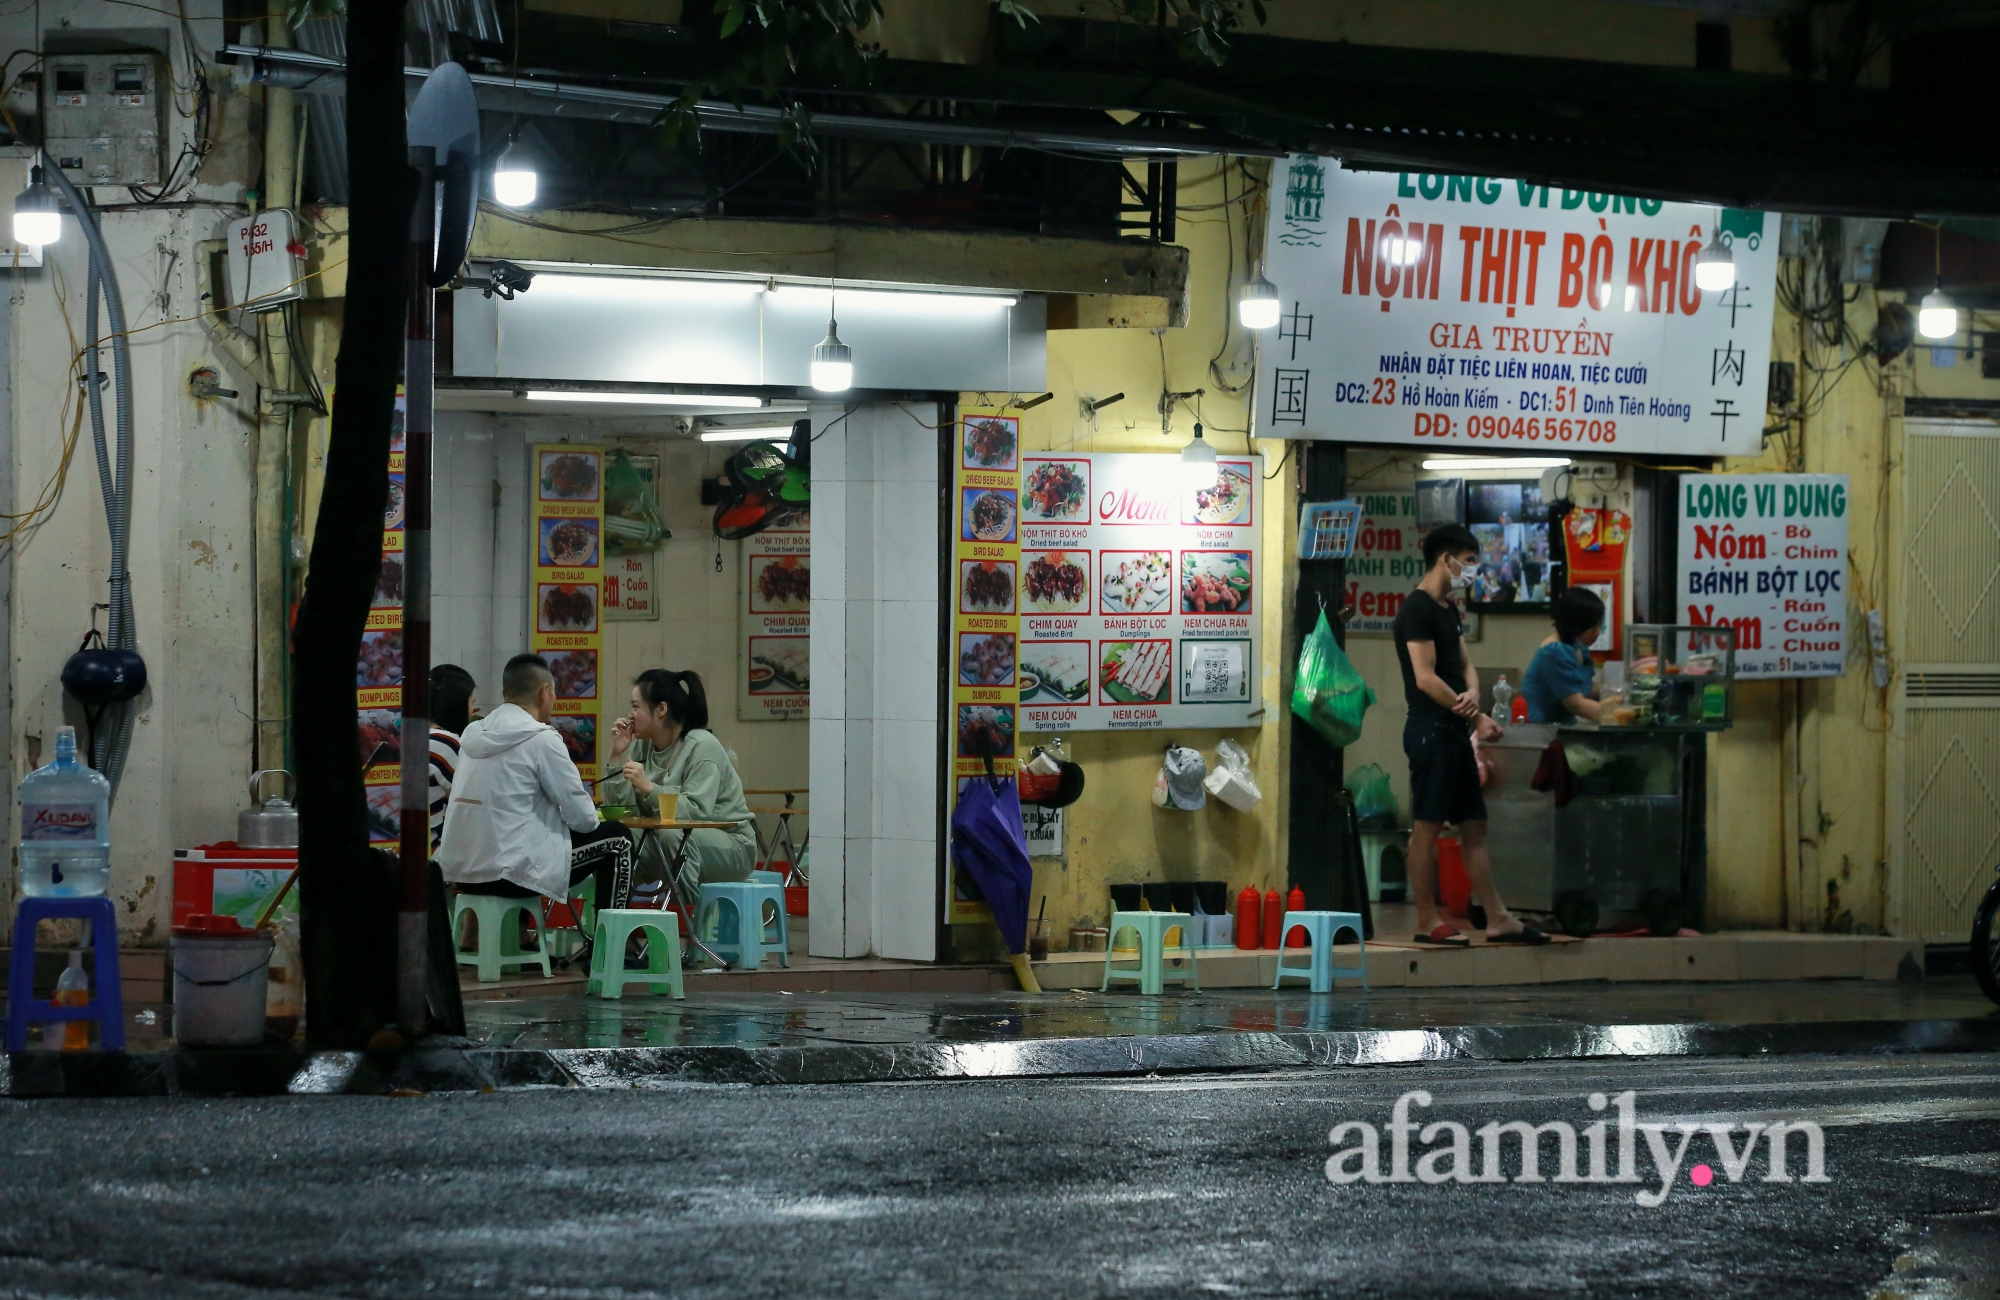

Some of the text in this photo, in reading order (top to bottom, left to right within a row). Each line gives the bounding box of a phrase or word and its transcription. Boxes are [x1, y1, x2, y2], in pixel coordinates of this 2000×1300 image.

[1398, 172, 1502, 205] LONG
[1516, 179, 1549, 208] VI
[1342, 203, 1704, 317] NỘM THỊT BÒ KHÔ
[1430, 317, 1613, 356] GIA TRUYỀN
[1272, 300, 1314, 427] 中国
[1380, 351, 1647, 385] NHẬN ĐẶT TIỆC LIÊN HOAN, TIỆC CƯỚI
[1372, 377, 1396, 405] 23
[1402, 382, 1421, 406] Hồ
[1425, 386, 1459, 408] Hoàn
[1464, 387, 1498, 409] Kiếm
[1555, 386, 1577, 412] 51
[1619, 396, 1645, 416] Tiên
[1650, 397, 1690, 423] Hoàng
[1414, 412, 1457, 438] DĐ:
[966, 475, 1013, 485] DRIED BEEF SALAD
[1099, 487, 1170, 520] Menu
[1686, 483, 1847, 518] LONG VI DUNG
[543, 506, 594, 515] DRIED BEEF SALAD
[1040, 529, 1057, 539] THỊT
[1060, 528, 1070, 539] BÒ
[1072, 528, 1087, 539] KHÔ
[1215, 531, 1233, 539] CHIM
[1354, 518, 1402, 557] ộm
[1785, 524, 1811, 539] Bò
[974, 547, 1004, 556] BIRD SALAD
[1694, 523, 1767, 567] Nộm
[1785, 545, 1838, 559] Chim
[626, 558, 642, 572] Rán
[1345, 556, 1384, 577] ÁNH
[552, 571, 584, 580] BIRD SALAD
[1689, 565, 1841, 598] BÁNH BỘT LỌC
[626, 576, 648, 591] Cuốn
[626, 597, 648, 610] Chua
[1784, 598, 1825, 613] Rán
[763, 617, 810, 626] CHIM QUAY
[968, 619, 1007, 628] ROASTED BIRD
[1029, 619, 1078, 630] CHIM QUAY
[1104, 617, 1167, 631] BÁNH BỘT LỌC
[1184, 616, 1247, 628] NEM CHUA RÁN
[1784, 615, 1840, 632] Cuốn
[546, 637, 588, 645] ROASTED BIRD
[1120, 630, 1150, 638] Dumplings
[1783, 639, 1840, 652] Chua
[1780, 657, 1791, 671] 51
[359, 692, 400, 703] DUMPLINGS
[972, 691, 1001, 700] DUMPLINGS
[763, 699, 782, 708] NEM
[1029, 707, 1077, 721] NEM CUỐN
[1113, 709, 1157, 719] NEM CHUA
[1035, 721, 1055, 730] Spring
[1109, 720, 1138, 728] Fermented
